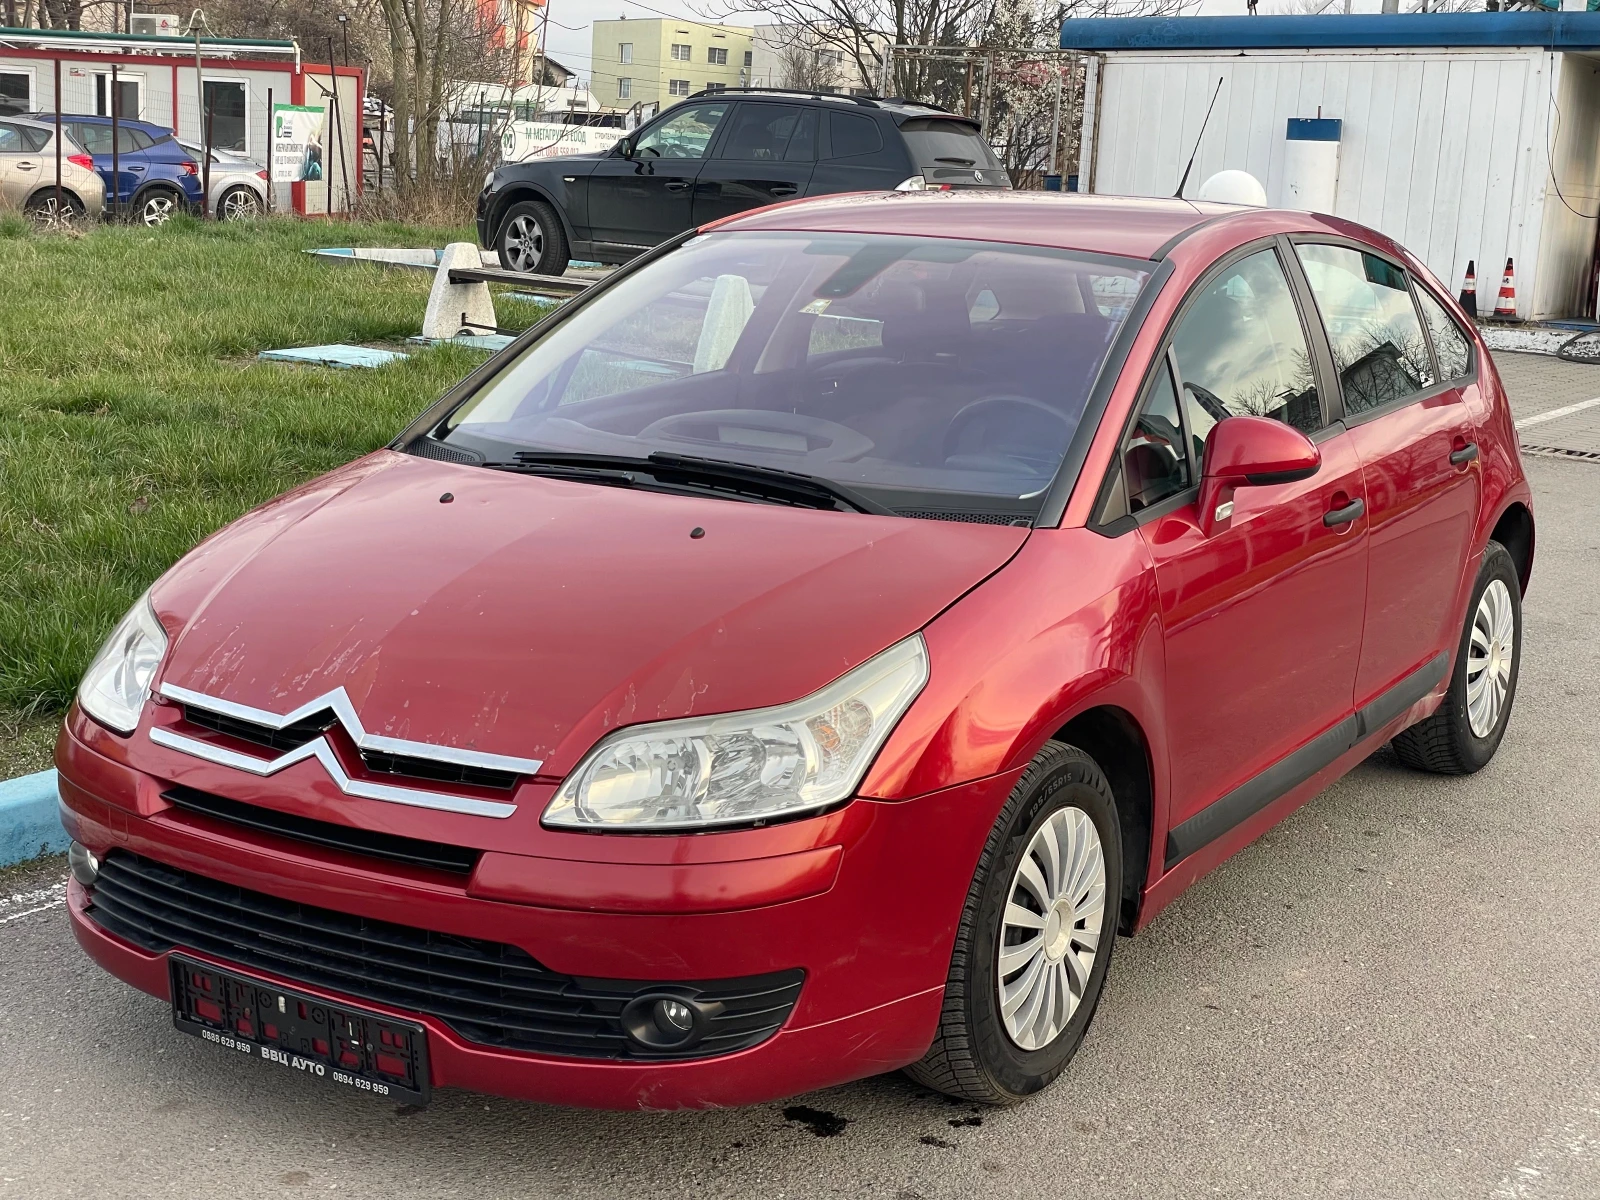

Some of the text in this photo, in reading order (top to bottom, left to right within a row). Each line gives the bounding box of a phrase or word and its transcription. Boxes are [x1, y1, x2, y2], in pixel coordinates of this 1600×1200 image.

[1029, 772, 1072, 818] 195/65R15
[201, 1029, 220, 1044] 0888
[220, 1036, 235, 1048] 629
[236, 1041, 251, 1054] 959
[260, 1045, 289, 1067] ВВЦ
[291, 1056, 325, 1077] АУТО
[333, 1071, 354, 1086] 0894
[355, 1078, 371, 1091] 629
[372, 1083, 389, 1096] 959
